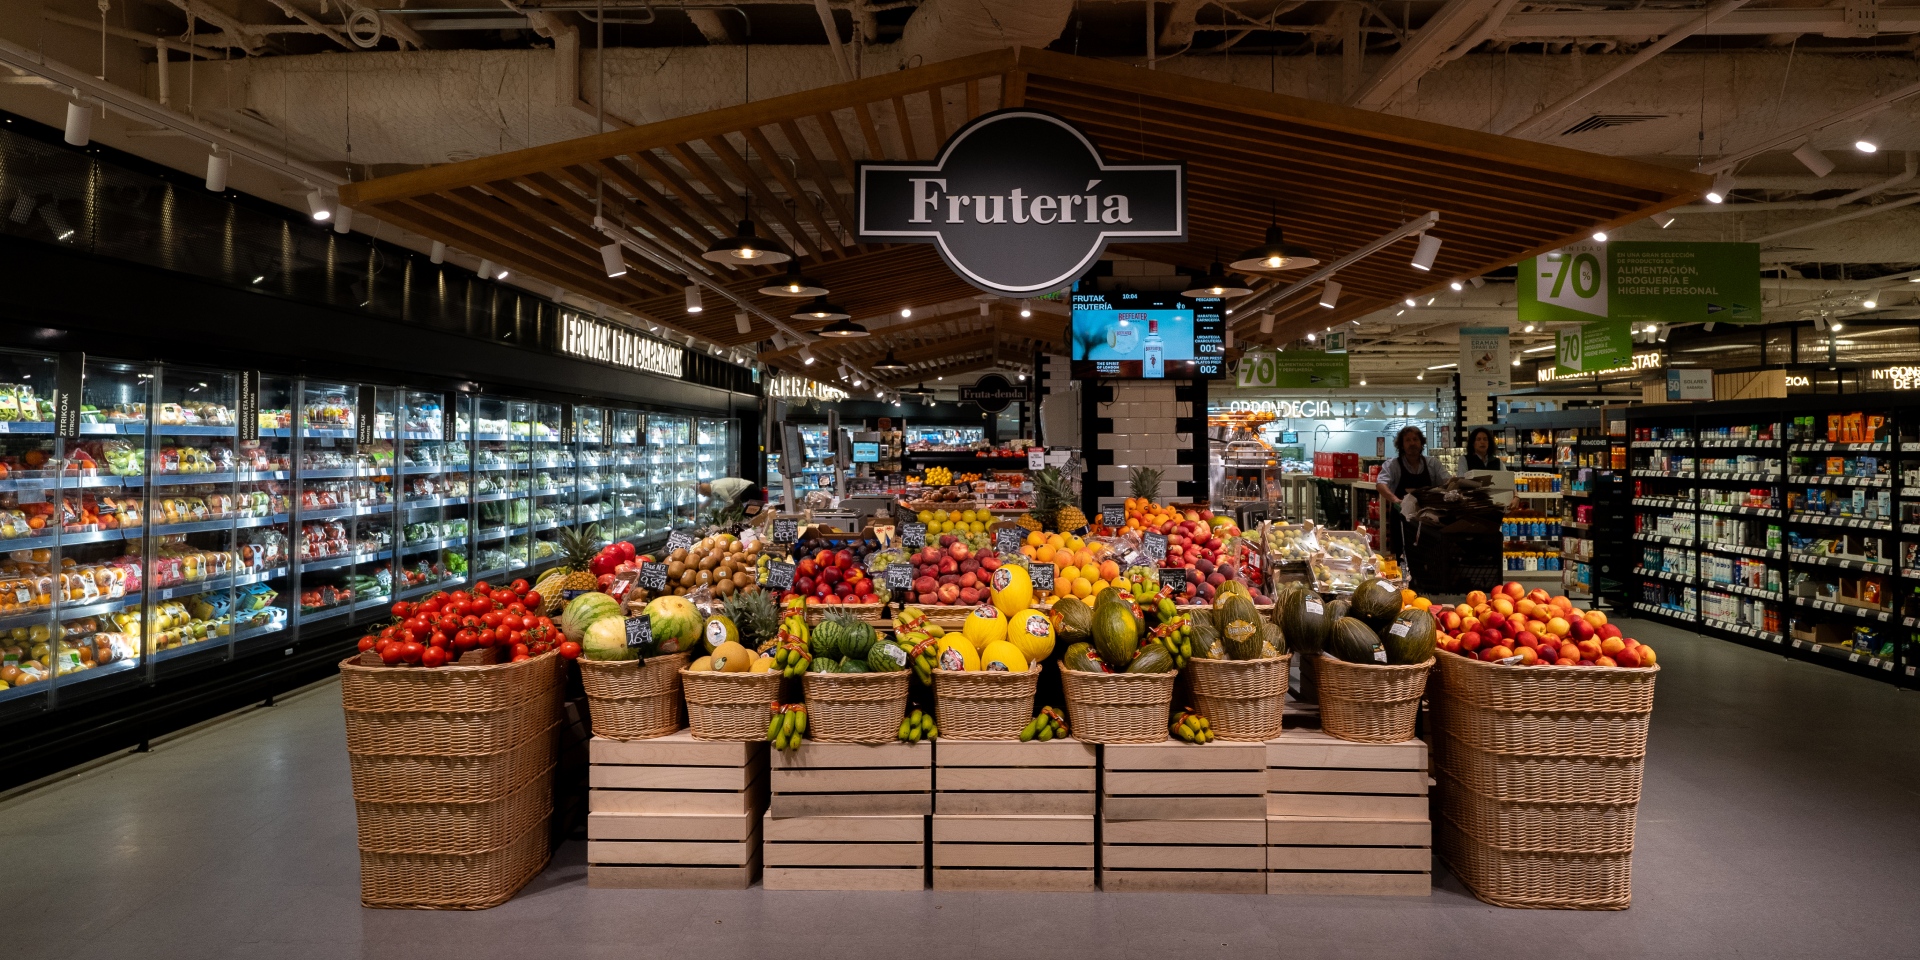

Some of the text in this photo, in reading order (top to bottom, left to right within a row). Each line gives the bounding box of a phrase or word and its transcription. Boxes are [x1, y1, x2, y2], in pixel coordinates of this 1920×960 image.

[908, 178, 1132, 224] Frutería
[1540, 253, 1601, 298] -70
[1618, 265, 1698, 276] ALIMENTACIÓN,
[1618, 275, 1679, 285] DROGUERÍA
[1663, 287, 1718, 295] PERSONAL
[1118, 312, 1147, 321] BEEFEATER
[1668, 381, 1680, 392] 50
[1894, 379, 1910, 389] DE
[963, 388, 1023, 399] Fruta-denda
[60, 393, 68, 437] ZITRIKOAK
